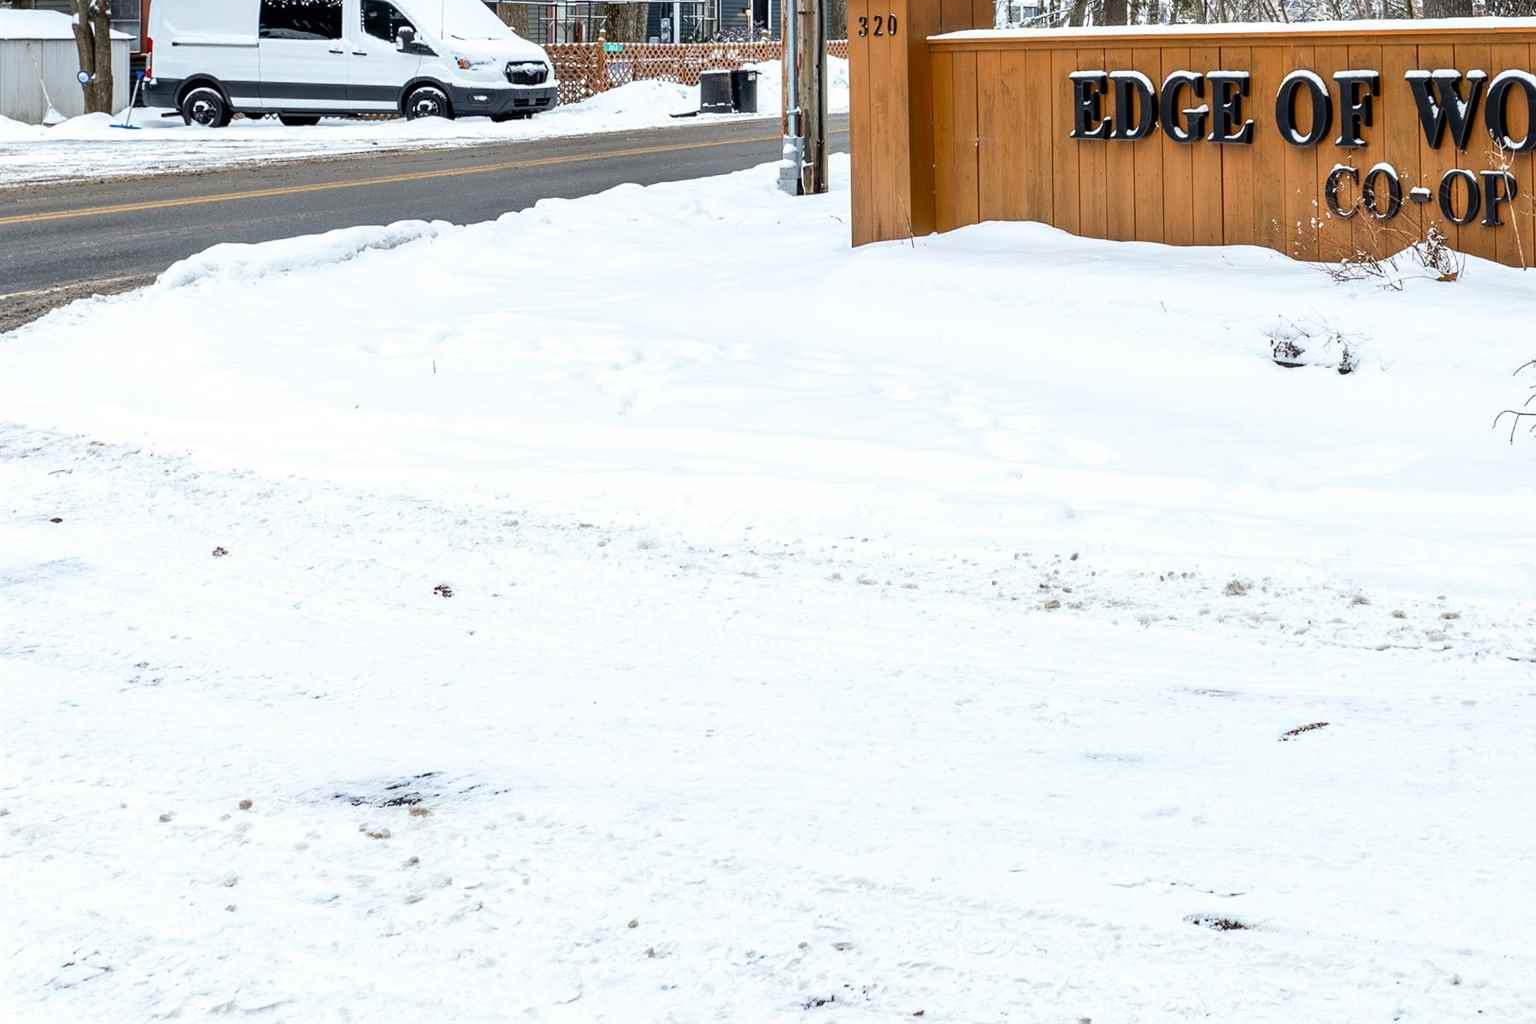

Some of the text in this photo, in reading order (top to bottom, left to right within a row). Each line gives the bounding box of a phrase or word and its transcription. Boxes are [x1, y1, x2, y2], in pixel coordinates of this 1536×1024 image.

[858, 15, 897, 37] 320
[1069, 70, 1254, 145] EDGE
[1275, 69, 1380, 148] OF
[1325, 162, 1517, 227] CO-OP
